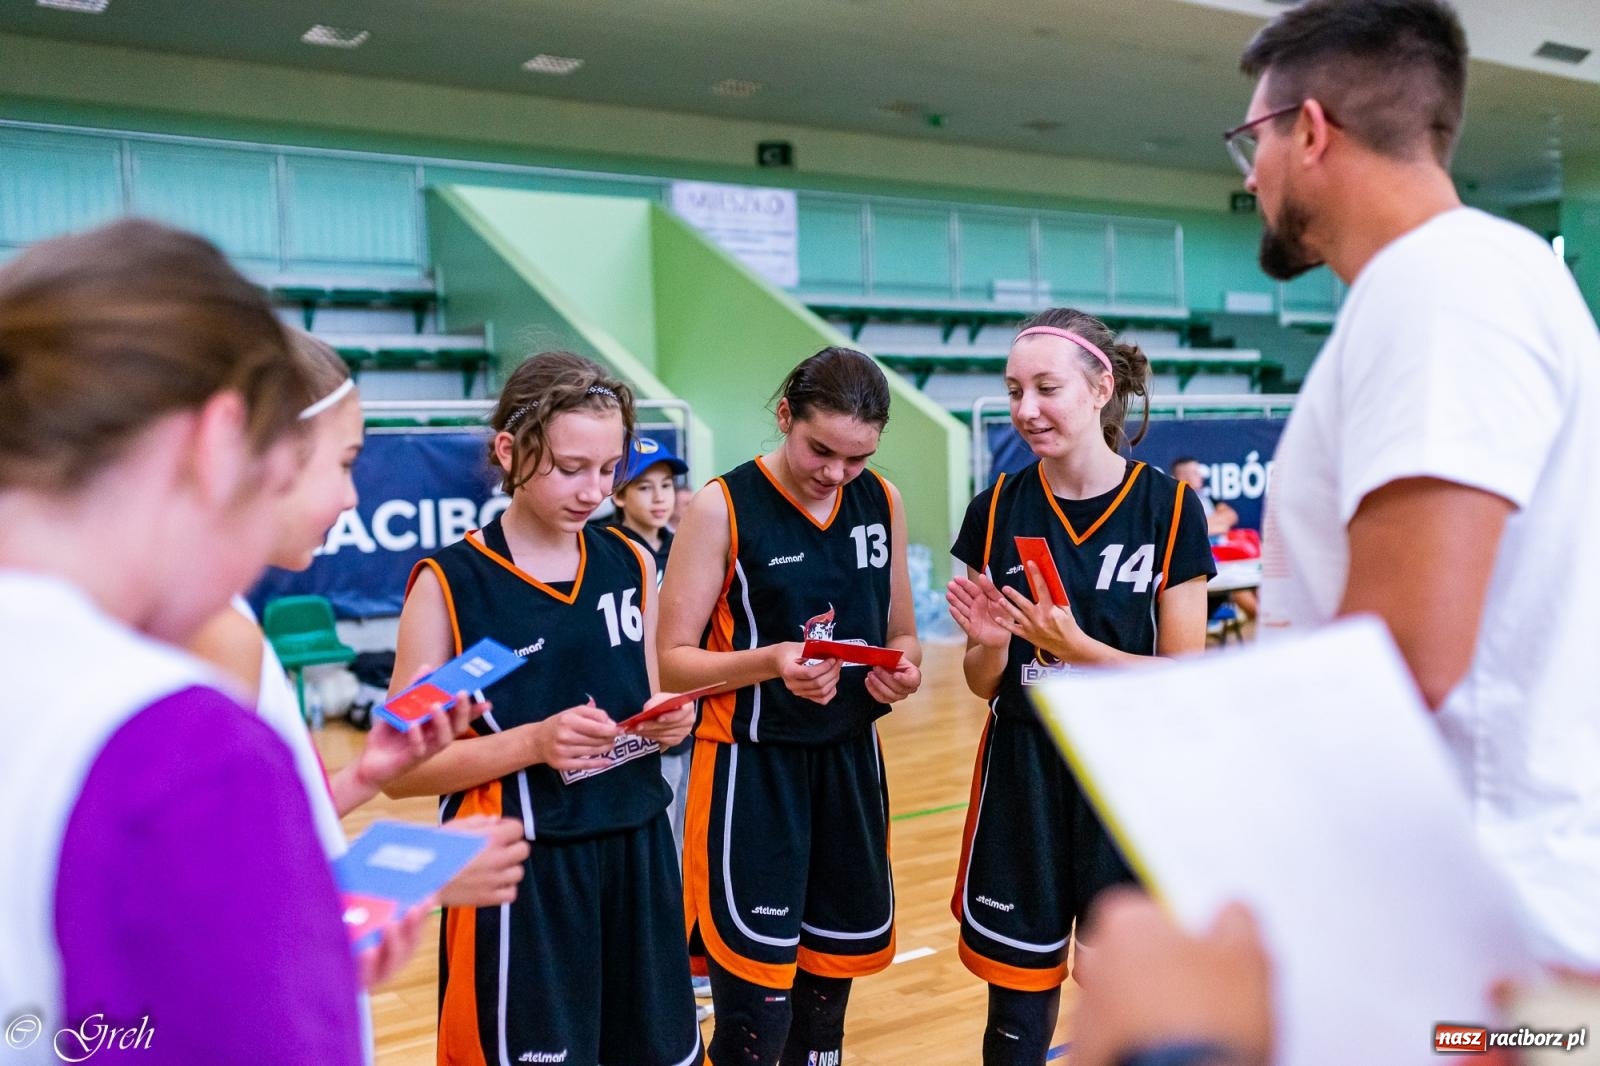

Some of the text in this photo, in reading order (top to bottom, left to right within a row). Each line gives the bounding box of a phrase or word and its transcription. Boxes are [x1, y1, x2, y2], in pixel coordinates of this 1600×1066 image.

[850, 523, 889, 569] 13
[1096, 544, 1155, 593] 14
[597, 587, 643, 647] 16
[818, 1049, 839, 1066] NBA
